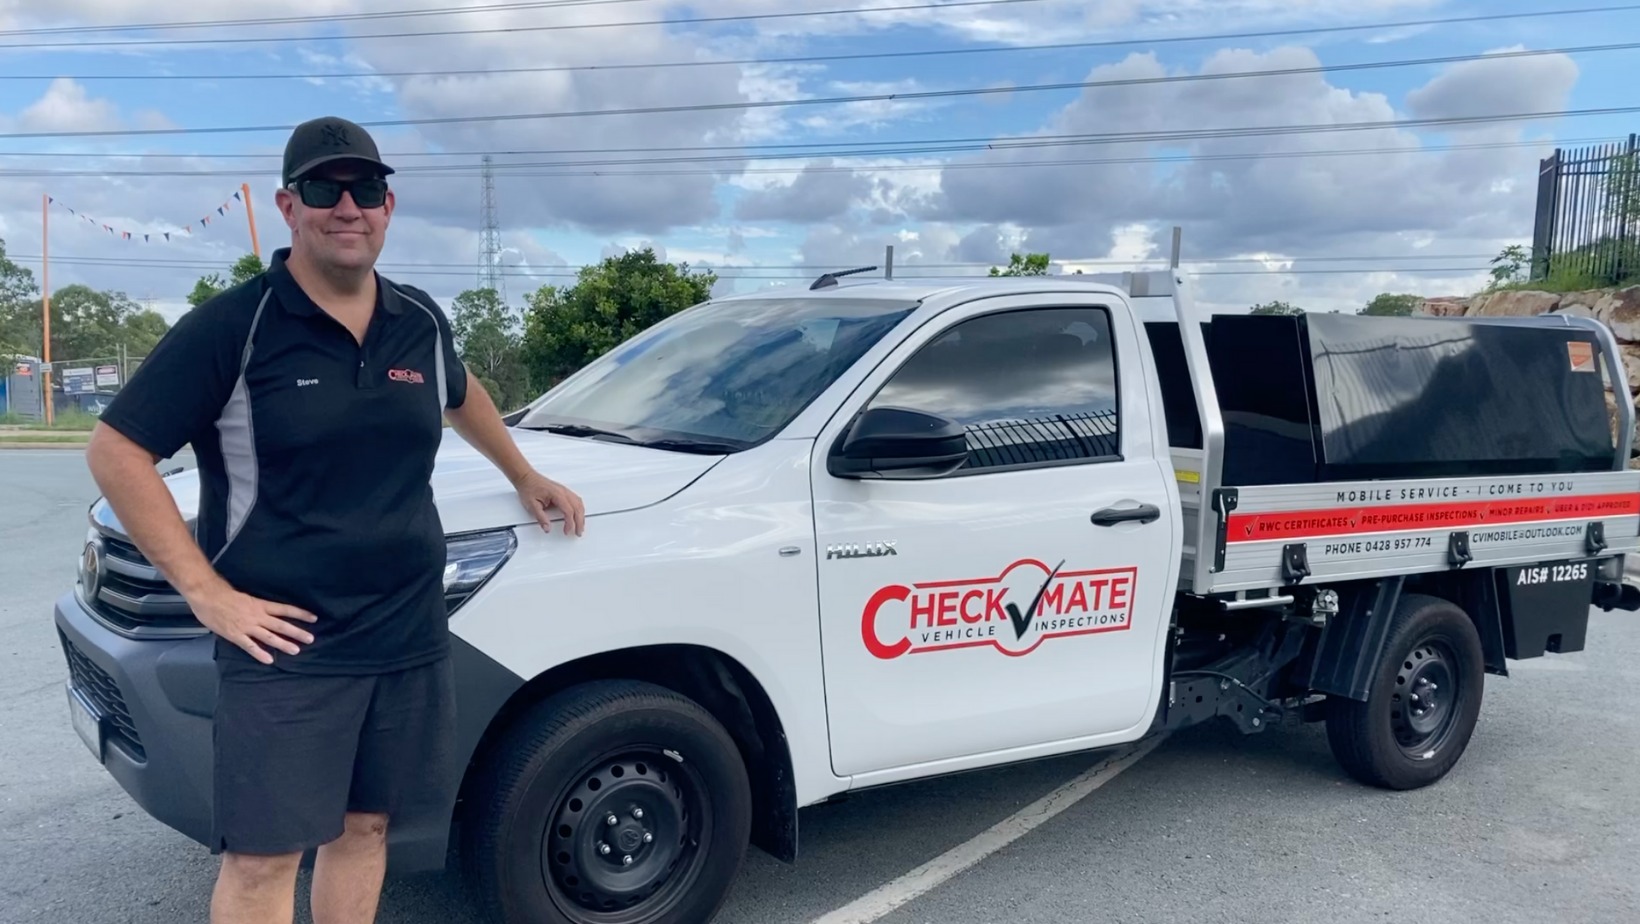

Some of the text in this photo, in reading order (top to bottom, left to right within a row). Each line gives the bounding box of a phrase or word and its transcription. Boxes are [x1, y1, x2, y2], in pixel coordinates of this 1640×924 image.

[320, 124, 350, 146] NY
[296, 378, 319, 387] Steve
[1336, 489, 1392, 503] MOBILE
[1400, 486, 1458, 500] SERVICE
[1477, 485, 1482, 496] I
[1489, 483, 1523, 495] COME
[1529, 482, 1544, 493] TO
[1551, 481, 1574, 492] YOU
[1259, 521, 1281, 532] RWC
[1284, 517, 1348, 531] CERTIFICATES
[1361, 512, 1424, 525] PRE-PURCHASE
[1426, 509, 1477, 522] INSPECTIONS
[1489, 507, 1513, 517] MINOR
[1514, 505, 1544, 515] REPAIRS
[1554, 503, 1573, 513] UBER
[1597, 500, 1631, 510] APPROVED
[1325, 536, 1431, 555] PHONE 0428 957 774
[1472, 525, 1583, 544] CVIMOBILE@OUTLOOK.COM
[826, 539, 898, 560] HILUX
[1517, 563, 1588, 586] AIS# 12265
[1037, 577, 1130, 617] MATE
[921, 613, 1126, 643] VEHICLE INSPECTIONS
